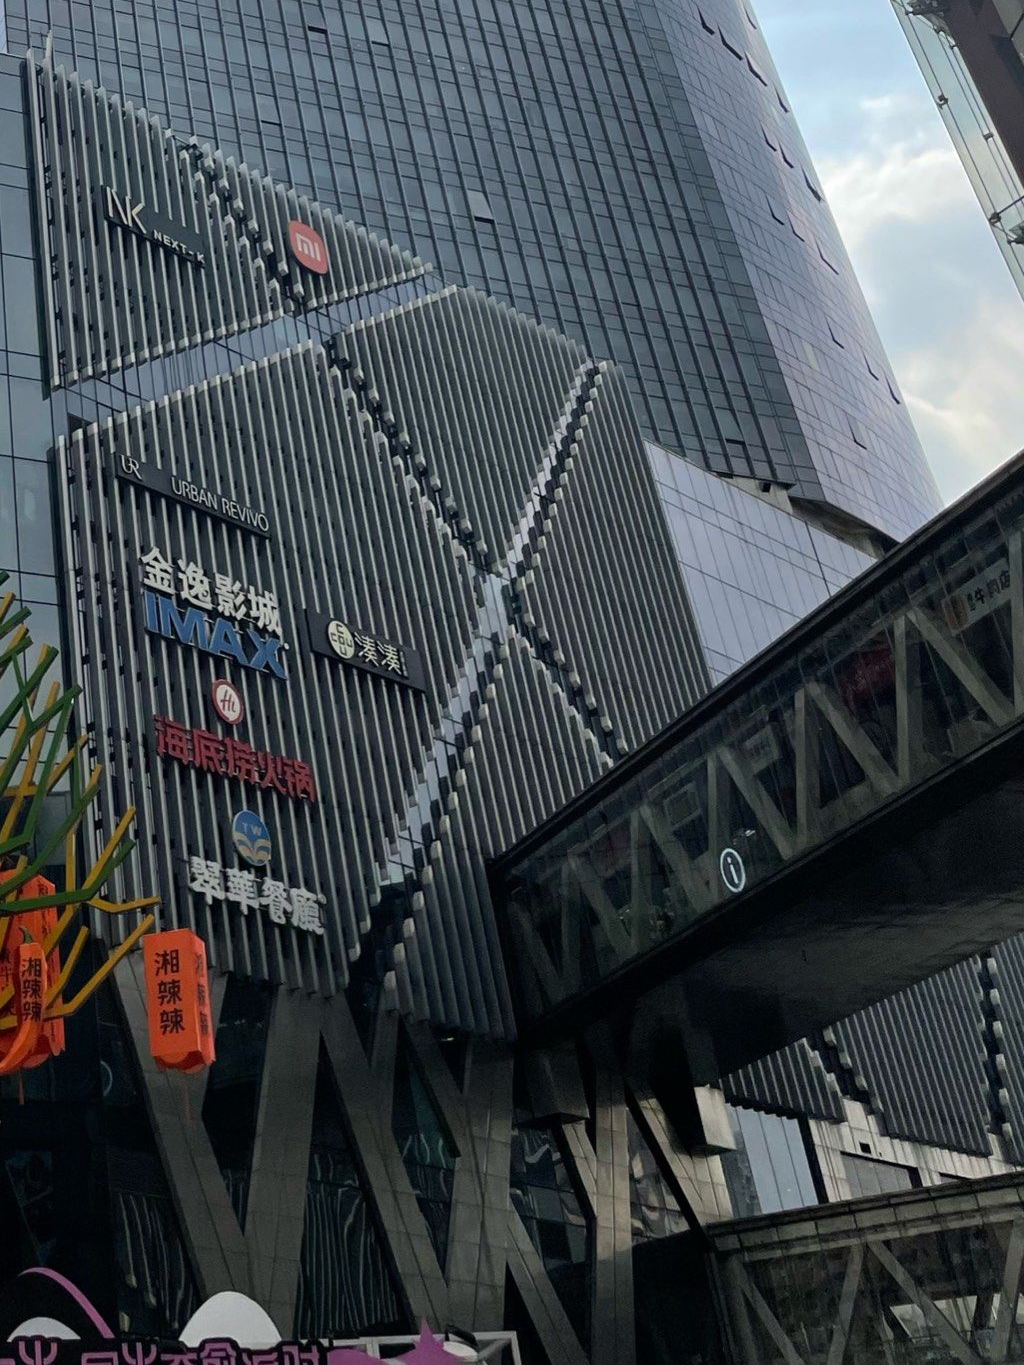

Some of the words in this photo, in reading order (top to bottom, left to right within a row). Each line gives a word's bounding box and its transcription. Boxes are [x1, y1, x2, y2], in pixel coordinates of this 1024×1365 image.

[171, 476, 218, 511] URBAN
[222, 498, 269, 532] REVIVO
[141, 546, 283, 638] 金逸影城
[144, 590, 289, 681] IMAX
[154, 714, 316, 804] 海底捞火锅
[21, 957, 42, 1022] 湘辣辣
[154, 948, 185, 1036] 湘辣辣
